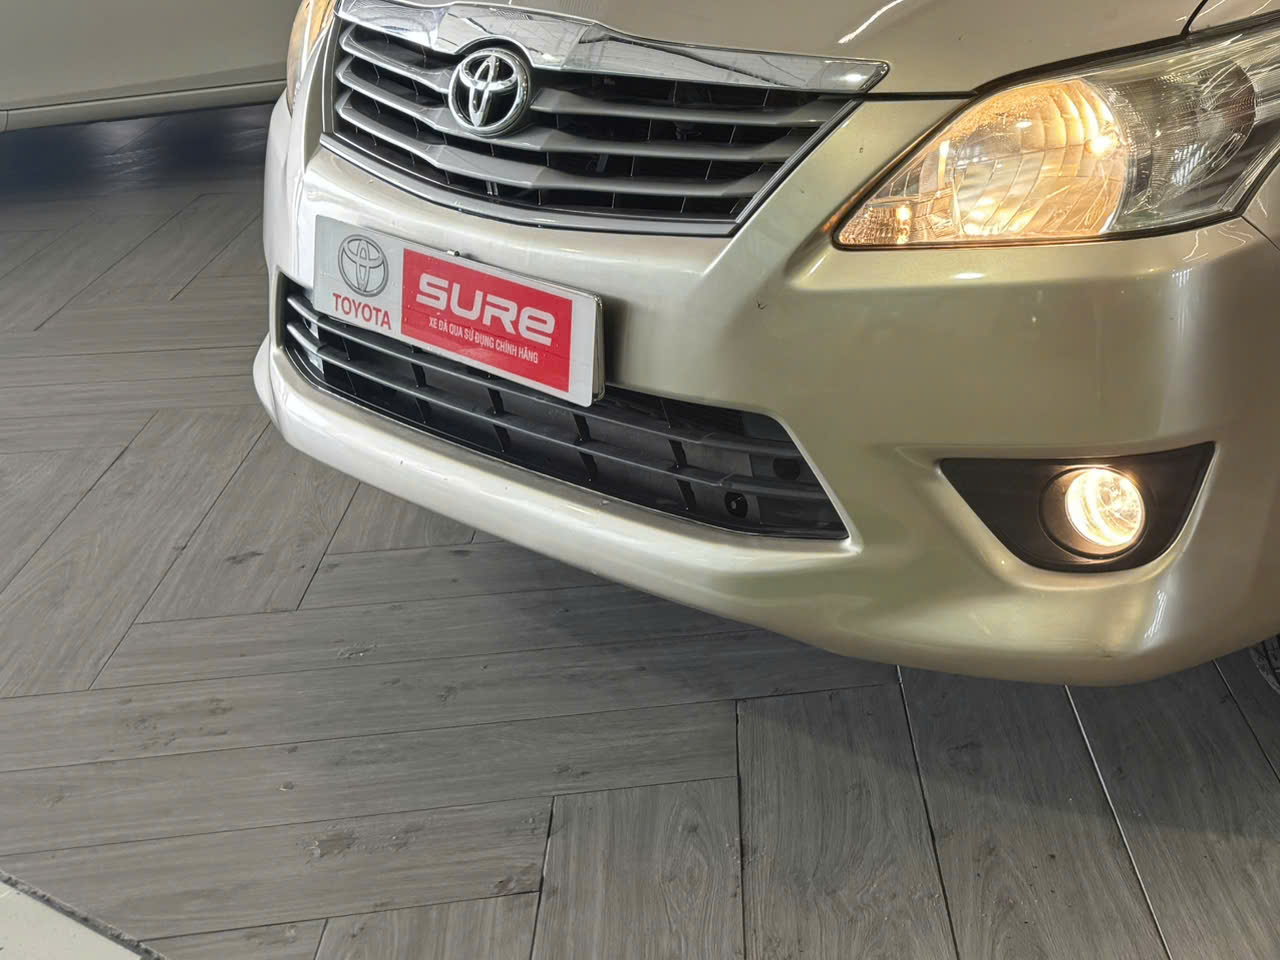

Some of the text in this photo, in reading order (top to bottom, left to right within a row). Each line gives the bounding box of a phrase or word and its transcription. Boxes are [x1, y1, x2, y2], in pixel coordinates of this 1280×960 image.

[331, 292, 392, 331] TOYOTA
[428, 316, 438, 329] XE
[449, 324, 463, 337] QUA
